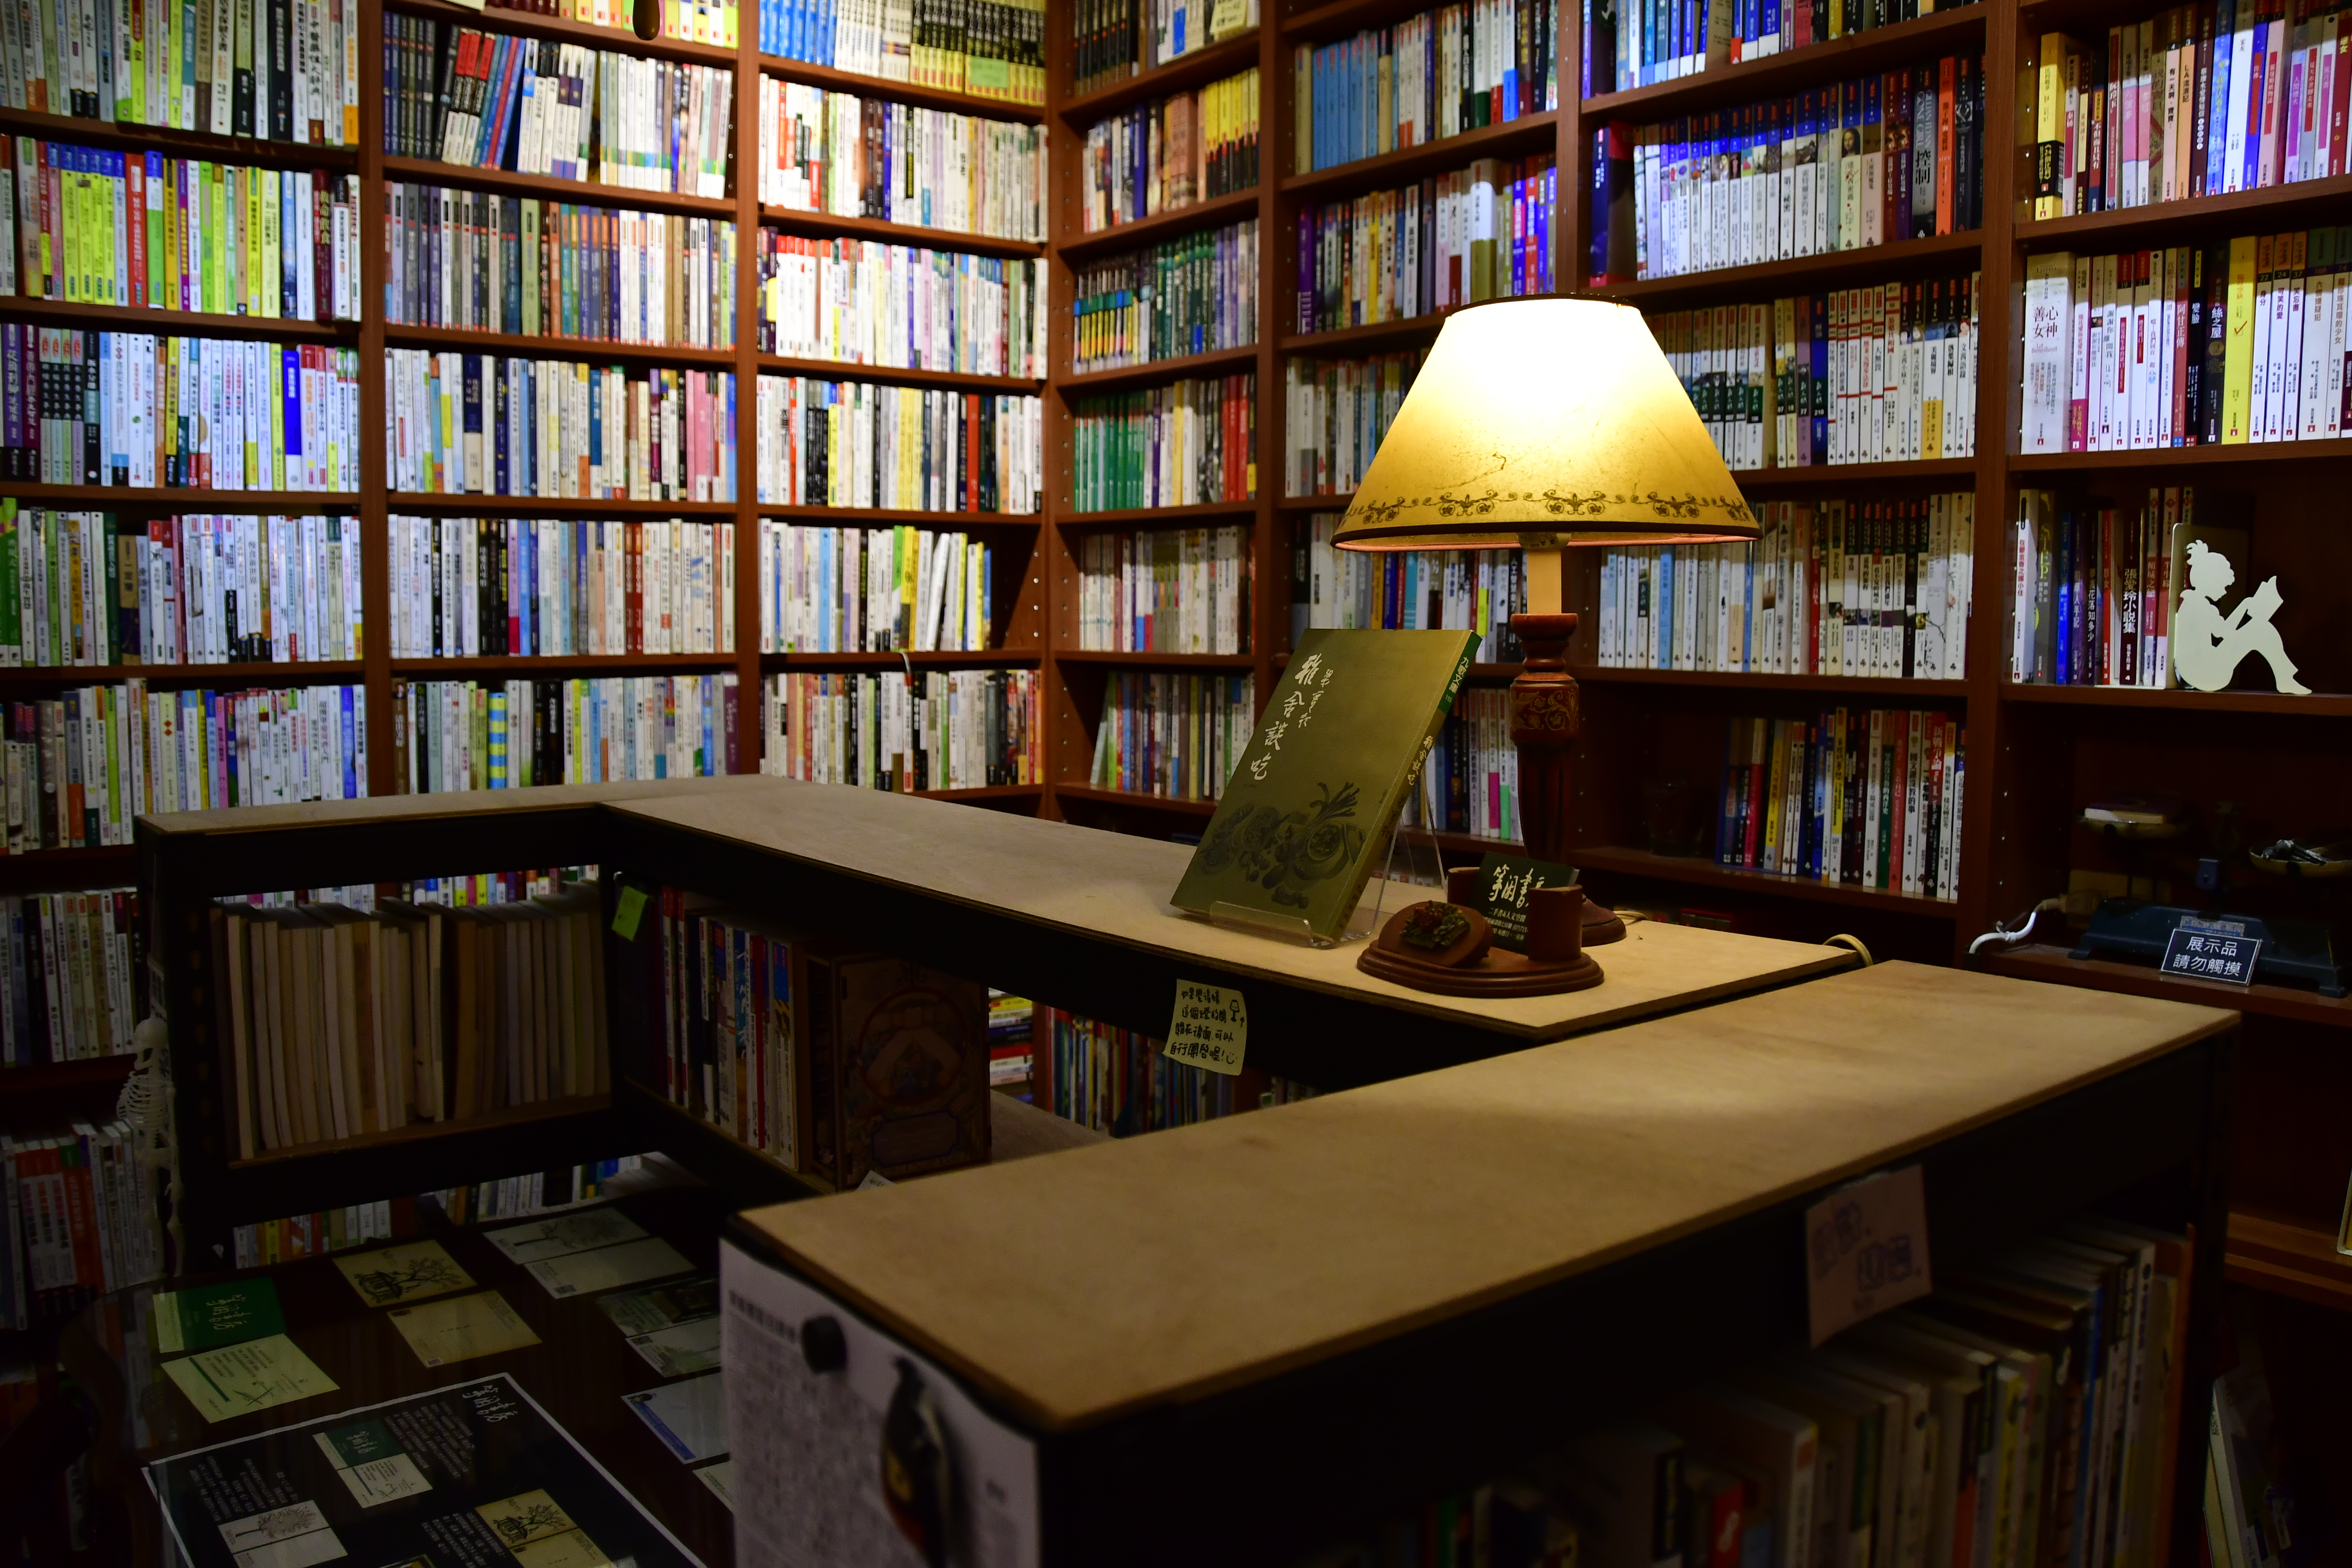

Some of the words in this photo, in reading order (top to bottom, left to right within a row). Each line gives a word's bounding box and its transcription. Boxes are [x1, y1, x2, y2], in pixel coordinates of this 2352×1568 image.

[1915, 150, 1931, 185] 控制
[2034, 306, 2059, 322] 善心
[2276, 287, 2285, 320] 可笑的愛
[2033, 322, 2058, 338] 女神
[2176, 304, 2186, 348] 阿甘正傳
[2210, 308, 2223, 339] 絲之屋
[1448, 656, 1469, 694] 九歌文庫
[1250, 653, 1322, 781] 雅舍談吃
[2186, 936, 2238, 957] 展示品
[2172, 953, 2242, 977] 請勿觸摸
